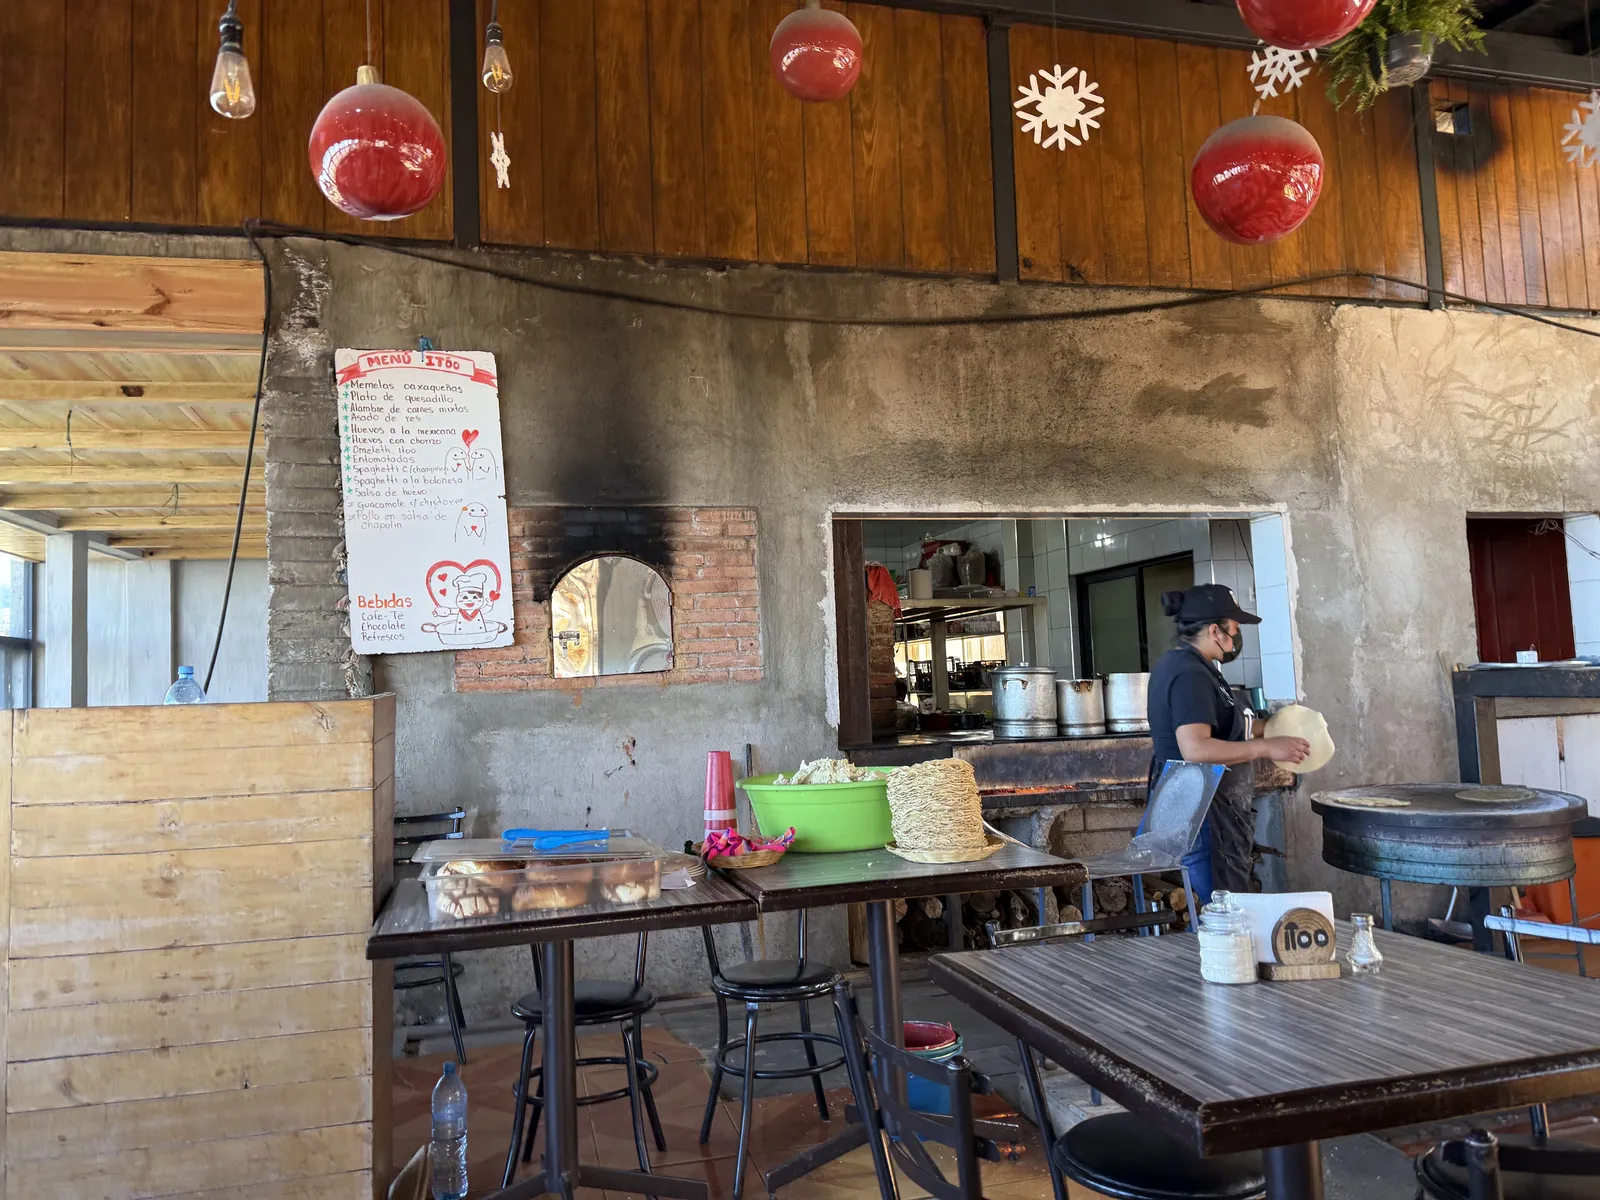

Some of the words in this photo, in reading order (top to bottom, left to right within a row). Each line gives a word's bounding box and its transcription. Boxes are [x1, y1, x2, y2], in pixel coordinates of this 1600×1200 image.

[367, 352, 412, 367] MENÚ
[350, 379, 394, 389] Memelas
[404, 383, 463, 393] oaxaqueñas
[350, 391, 377, 401] Plato
[383, 392, 394, 401] de
[350, 403, 384, 412] Alambre
[390, 404, 400, 413] de
[438, 404, 469, 414] mixtas
[351, 413, 379, 422] Asado
[384, 414, 396, 422] de
[351, 424, 384, 434] Huevos
[402, 426, 410, 434] la
[352, 434, 382, 444] Huevos
[353, 454, 416, 464] Entomatadas
[353, 464, 398, 476] Spaghetti
[354, 475, 398, 488] Spaghetti
[410, 476, 420, 484] la
[355, 488, 381, 497] Salsa
[385, 487, 398, 497] de
[402, 488, 427, 496] huevo
[356, 510, 380, 520] Pollo
[401, 510, 428, 520] salsa
[434, 510, 446, 520] de
[358, 593, 413, 608] Bebidas
[361, 620, 406, 632] Chocolate
[361, 632, 405, 642] Refrescos
